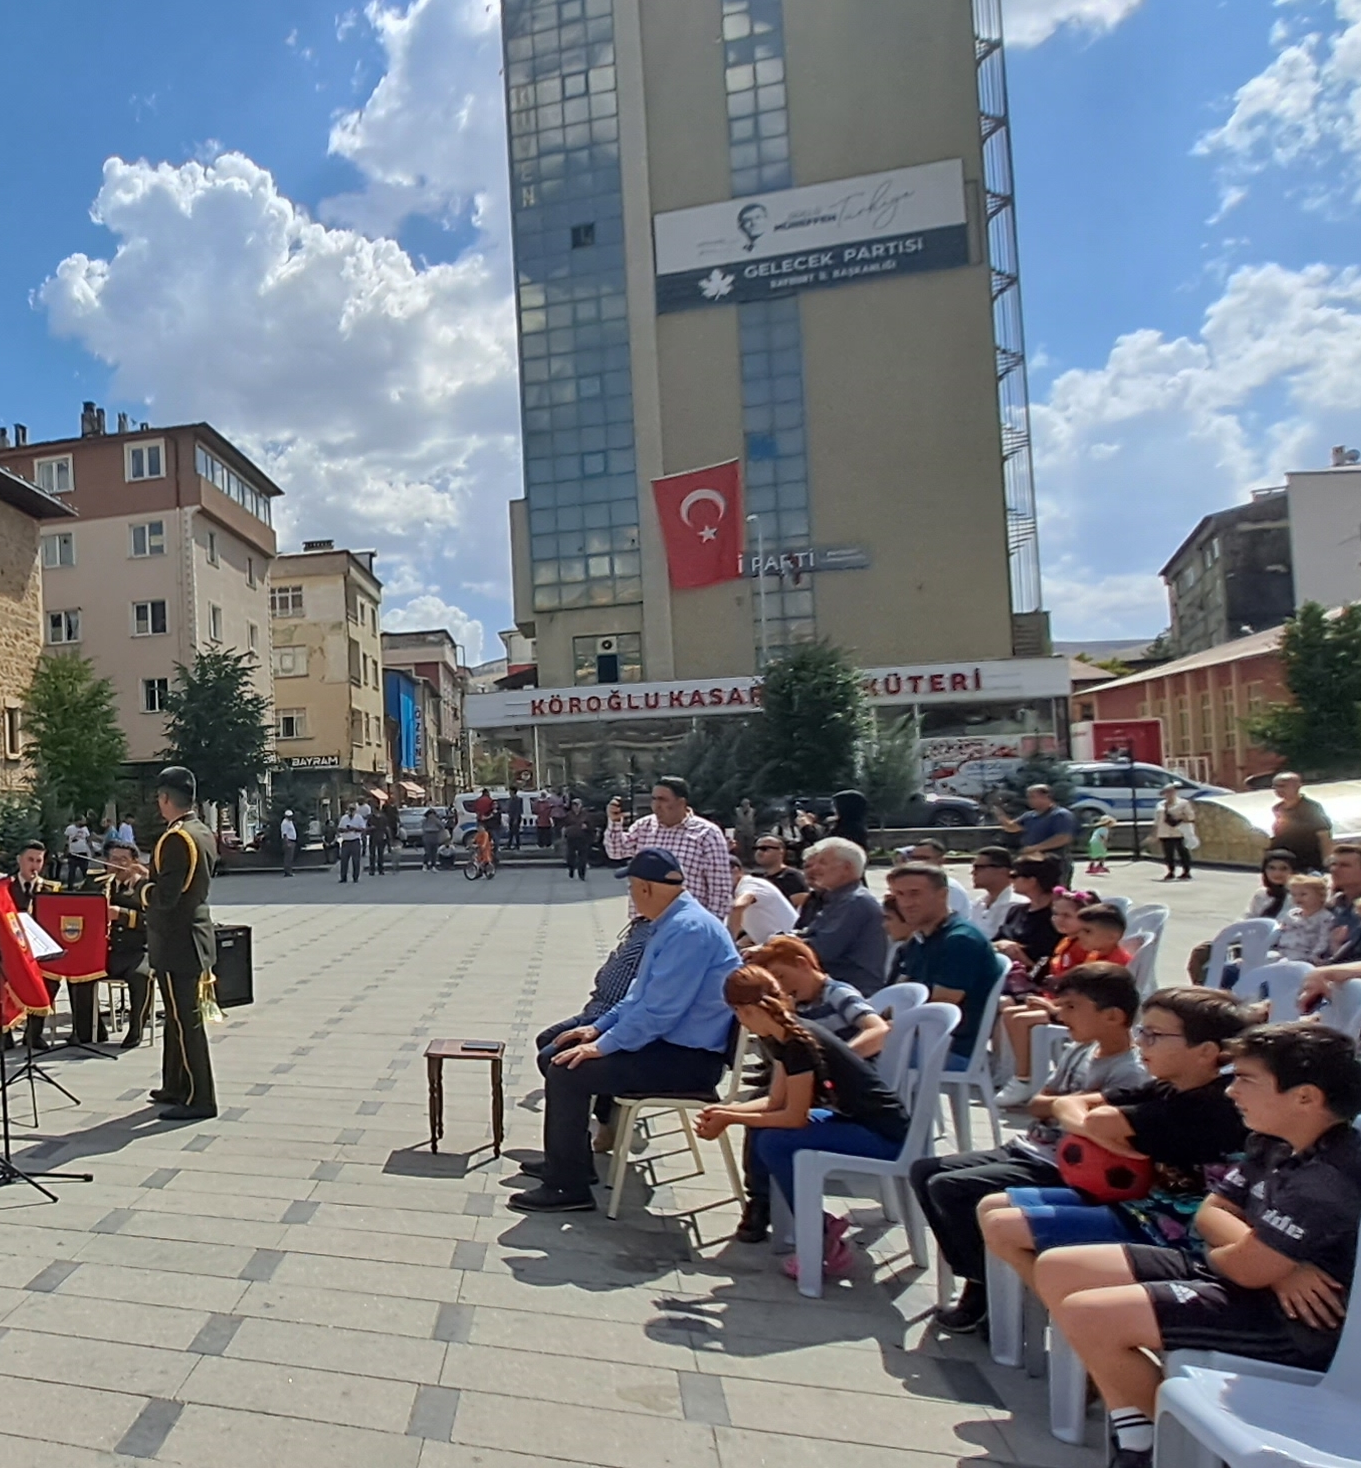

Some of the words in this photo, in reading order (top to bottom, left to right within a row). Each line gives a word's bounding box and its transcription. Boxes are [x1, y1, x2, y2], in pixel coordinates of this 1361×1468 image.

[744, 251, 833, 280] GELECEK
[843, 236, 924, 263] PARTİSİ
[531, 690, 660, 717] KÖROĞLU
[861, 667, 983, 697] KÜTERİ
